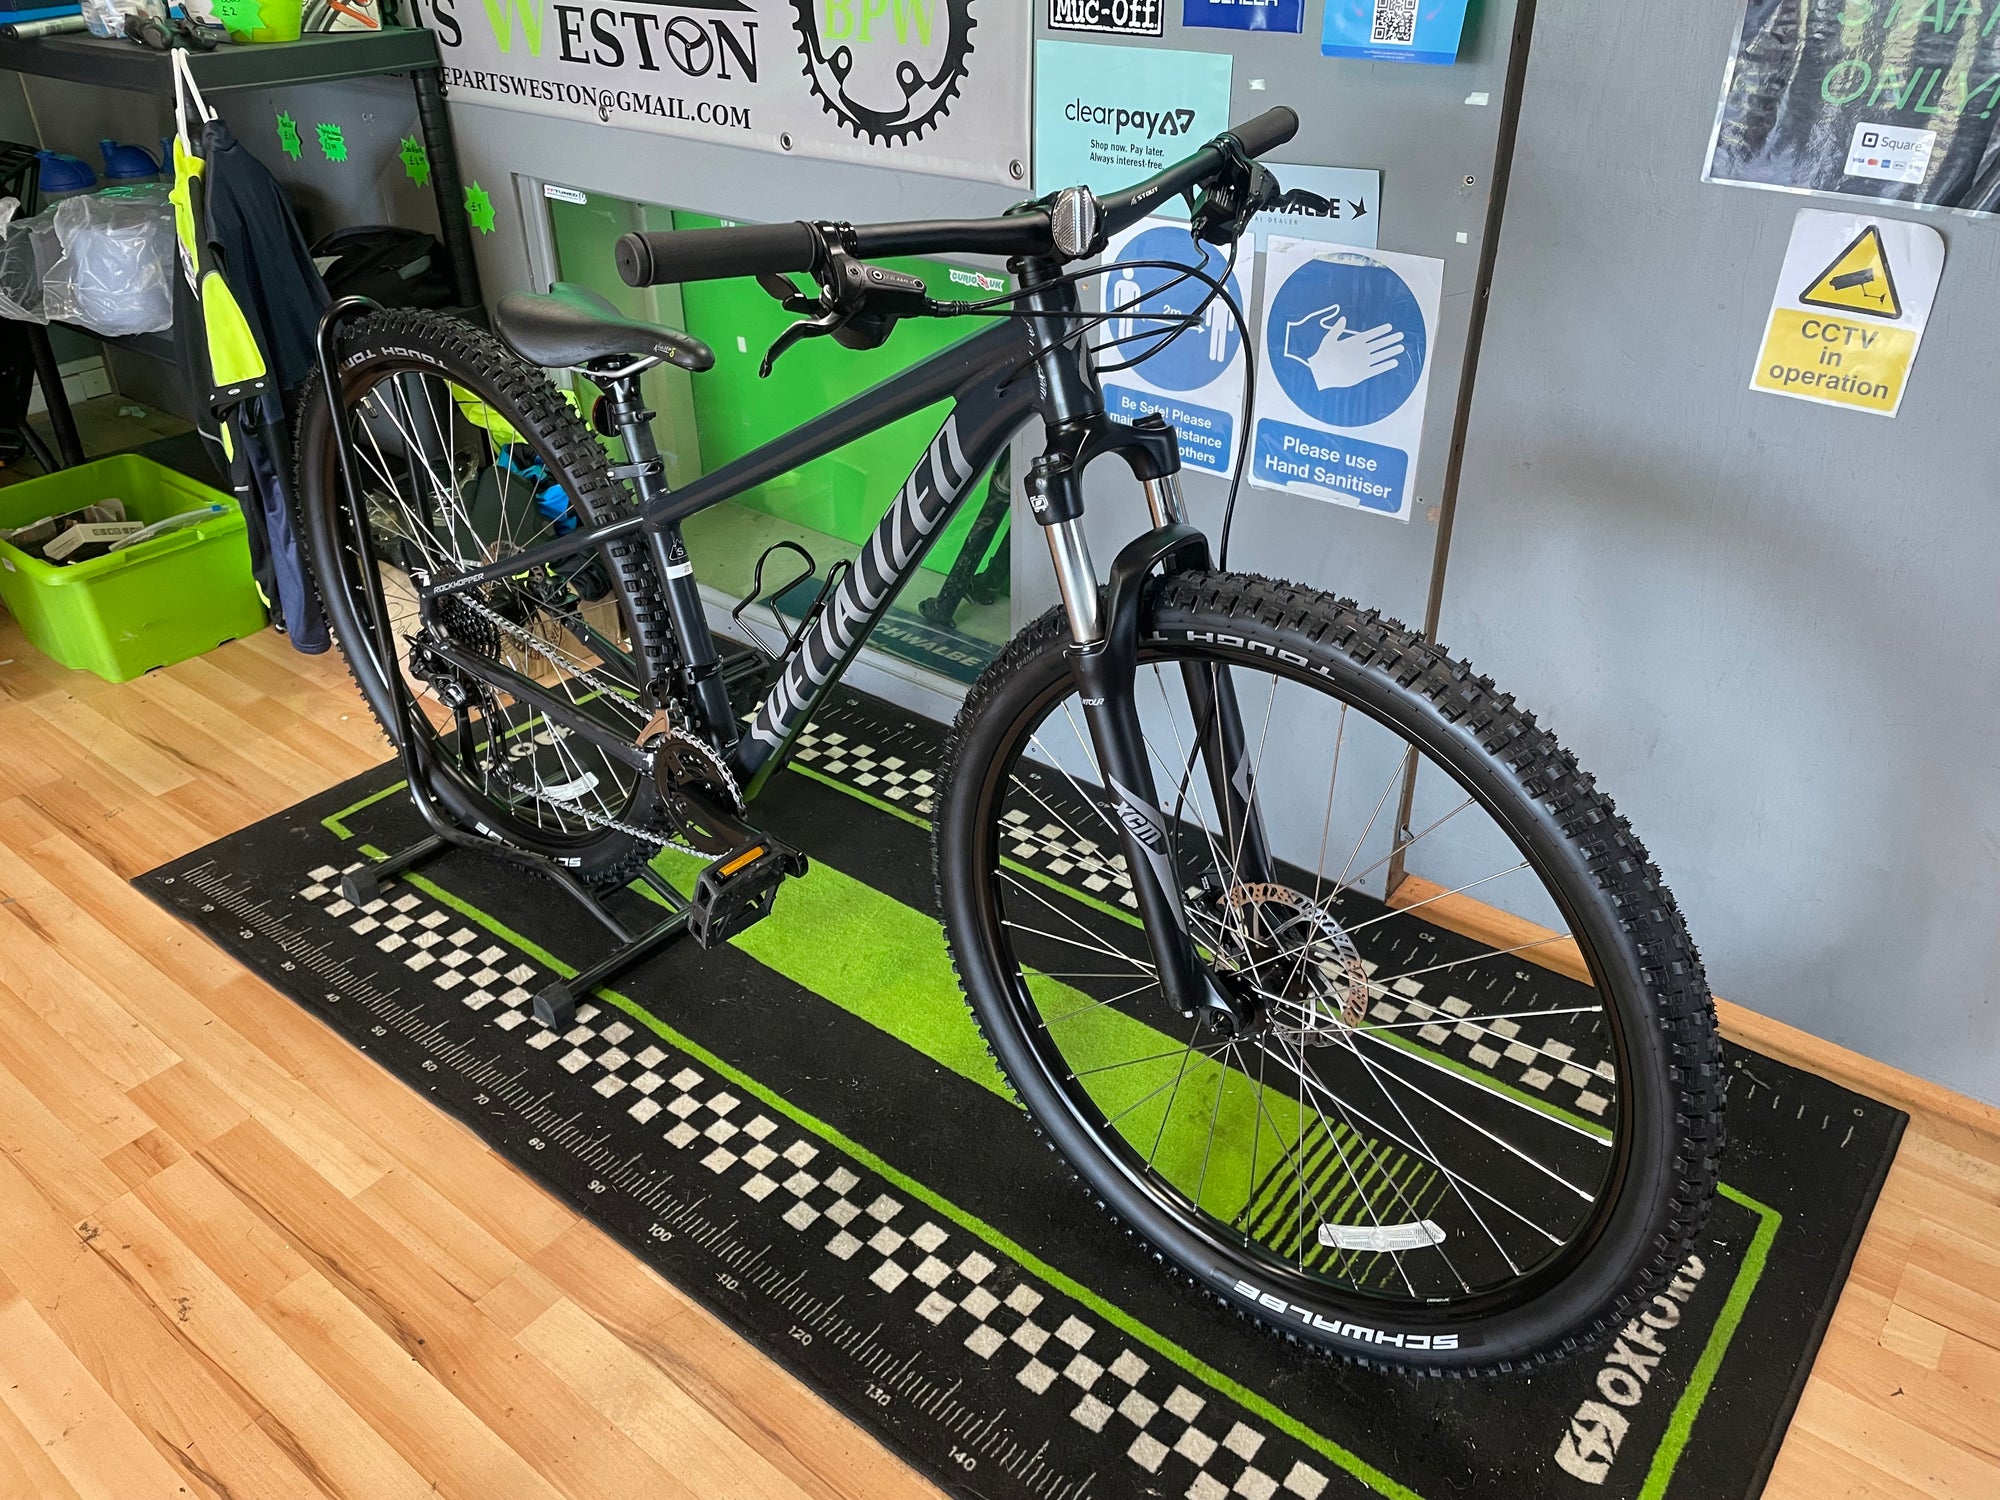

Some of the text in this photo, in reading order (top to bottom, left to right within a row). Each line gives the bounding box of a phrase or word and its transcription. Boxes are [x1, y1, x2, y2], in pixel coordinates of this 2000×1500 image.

[823, 0, 935, 46] BPW
[1055, 0, 1155, 28] Muc-Off
[441, 66, 752, 130] EPARTSWESTON@GMAIL.COM
[1065, 98, 1160, 139] clearpay
[1090, 139, 1165, 157] Shop now. Pay later.
[1881, 137, 1923, 151] Square
[1090, 152, 1165, 170] Always interest-free.
[1136, 186, 1159, 202] STOUT
[951, 272, 1003, 290] CURIO UK
[1801, 319, 1880, 350] CCTV
[381, 345, 449, 371] TOUGH
[1819, 345, 1843, 368] in
[1769, 364, 1889, 400] operation
[1121, 396, 1212, 429] Be Safe! Please
[1178, 446, 1216, 465] others
[1283, 435, 1378, 472] Please use
[1265, 454, 1392, 499] Hand Sanitiser
[433, 573, 484, 594] ROCKHOPPER
[751, 413, 974, 762] SPECIALIZED
[874, 623, 984, 667] CHWALBE
[1186, 630, 1336, 681] TOUGH
[281, 961, 296, 972] 30
[325, 993, 340, 1003] 40
[371, 1025, 387, 1037] 50
[421, 1060, 438, 1073] 60
[473, 1093, 490, 1106] 70
[528, 1137, 546, 1151] 80
[648, 1222, 673, 1243] 100
[1233, 1280, 1459, 1351] SCHWALBE
[787, 1324, 813, 1347] 120
[864, 1384, 891, 1407] 130
[948, 1445, 978, 1473] 140
